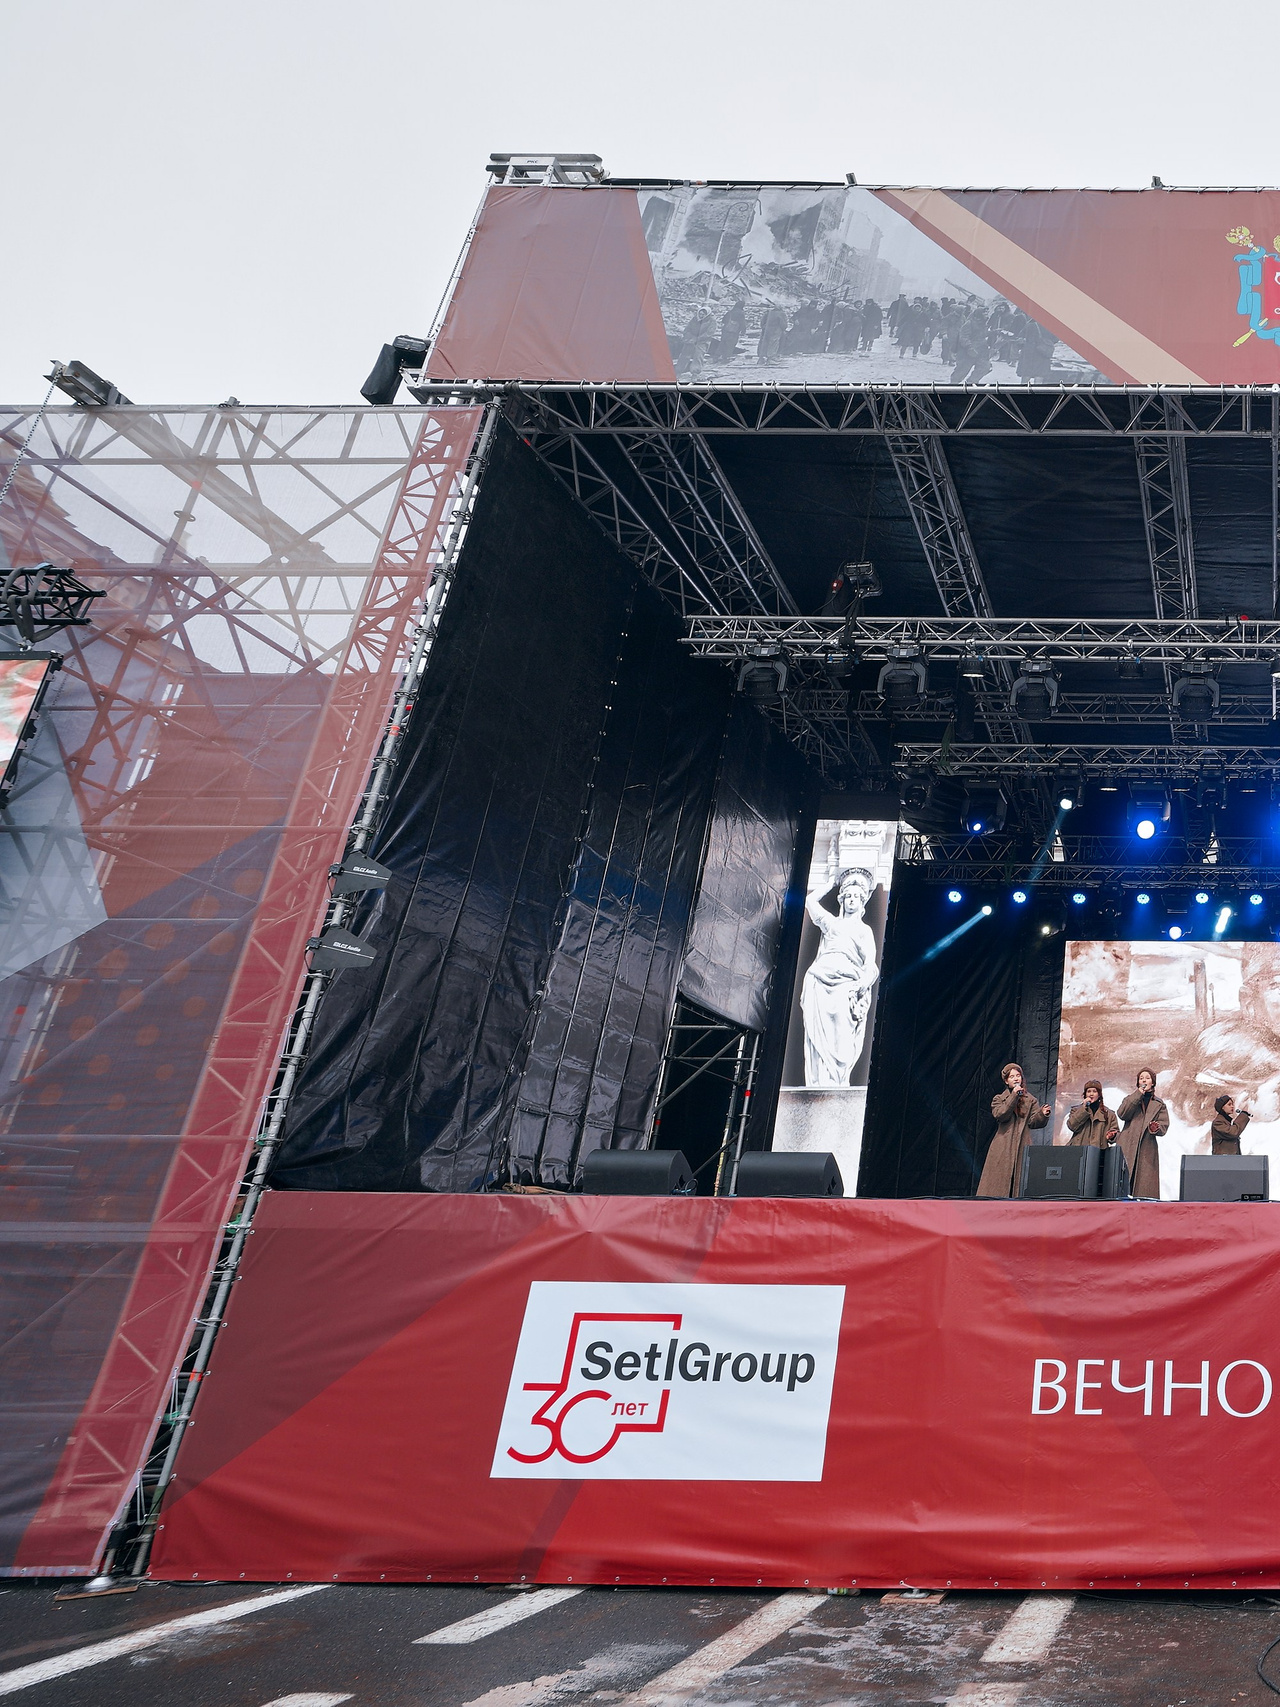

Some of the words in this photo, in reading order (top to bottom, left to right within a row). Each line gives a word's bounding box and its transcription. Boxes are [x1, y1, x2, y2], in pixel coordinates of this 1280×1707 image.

[580, 1338, 816, 1392] SetlGroup
[1030, 1358, 1273, 1418] ВЕЧНО
[506, 1382, 622, 1465] 30
[610, 1399, 649, 1416] лет
